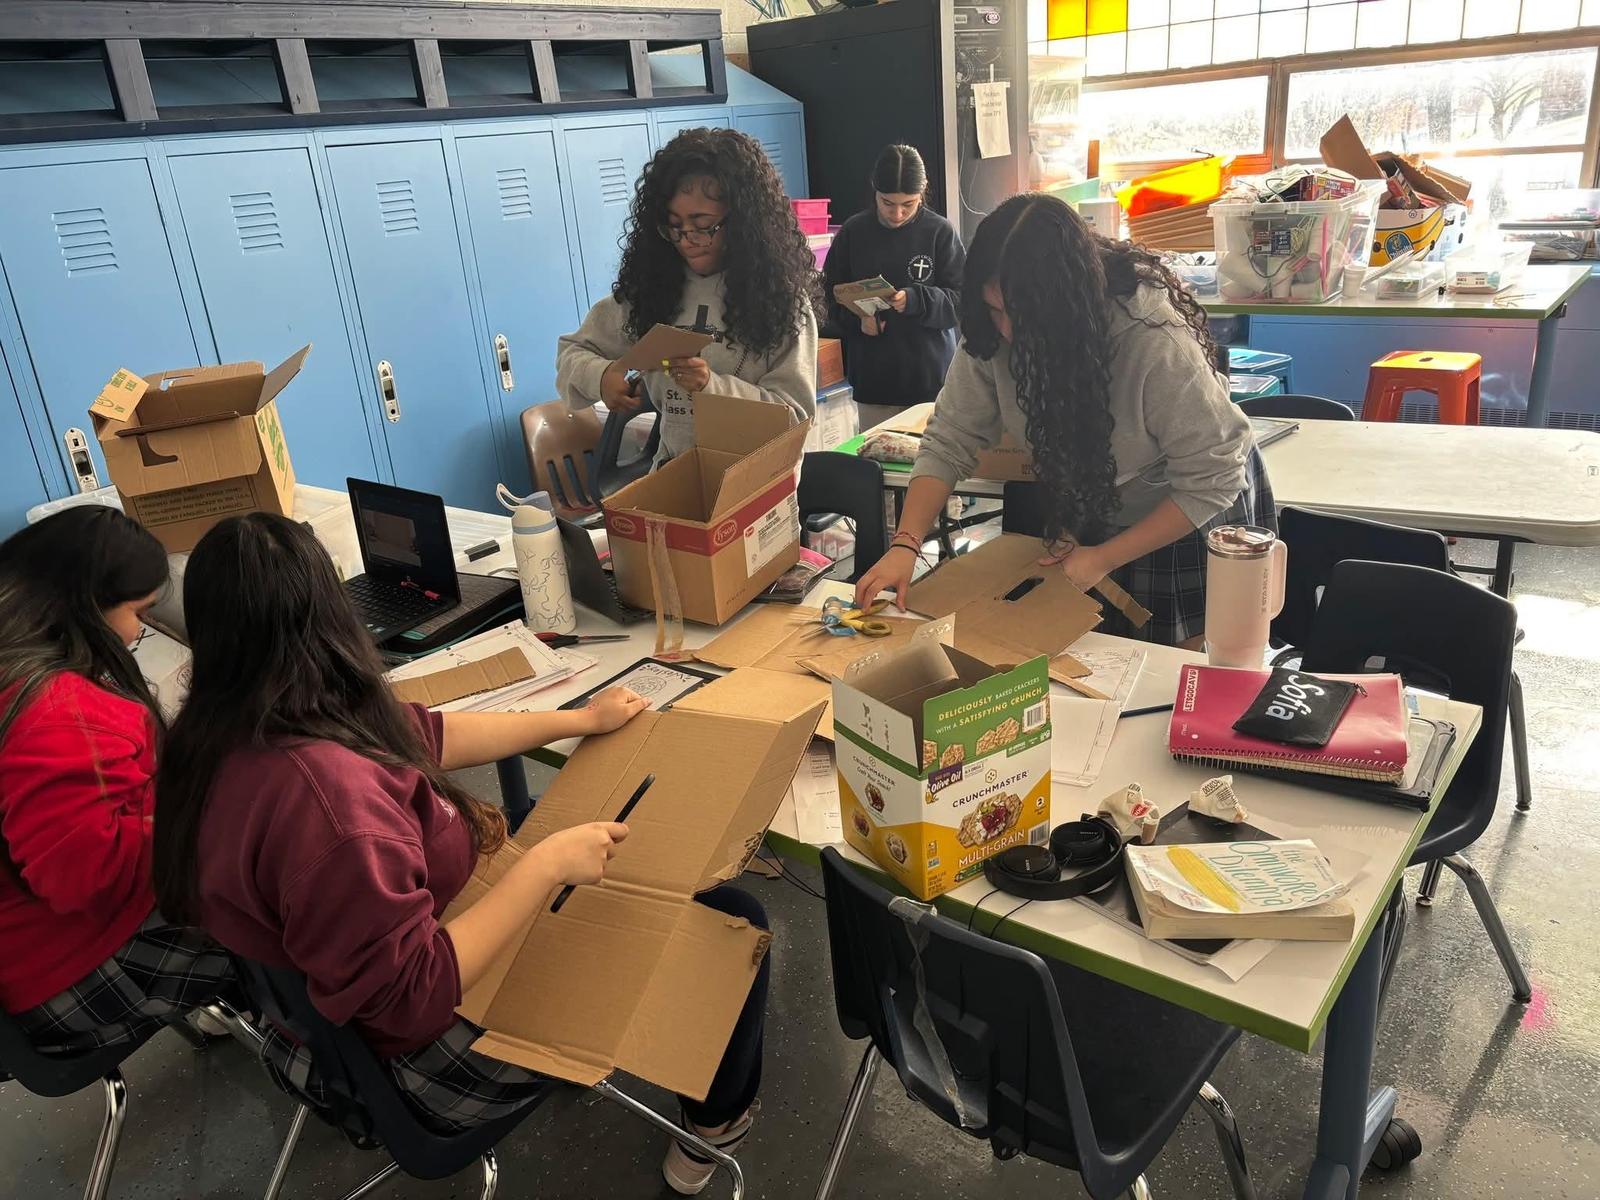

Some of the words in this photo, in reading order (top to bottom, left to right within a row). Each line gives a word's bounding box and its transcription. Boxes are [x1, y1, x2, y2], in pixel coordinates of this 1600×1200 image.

[665, 402, 686, 415] lass
[666, 389, 682, 400] St.
[935, 725, 952, 735] WITH
[959, 702, 1008, 726] SATISFYING
[1010, 687, 1042, 706] CRUNCH
[938, 695, 993, 721] DELICIOUSLY
[995, 688, 1013, 699] BAKED
[1013, 677, 1040, 693] CRACKERS
[1265, 674, 1325, 721] Sofia
[930, 777, 951, 793] Olive
[950, 770, 961, 783] Oil
[952, 771, 1028, 808] CRUNCHMASTER
[959, 828, 1025, 868] MULTI-GRAIN
